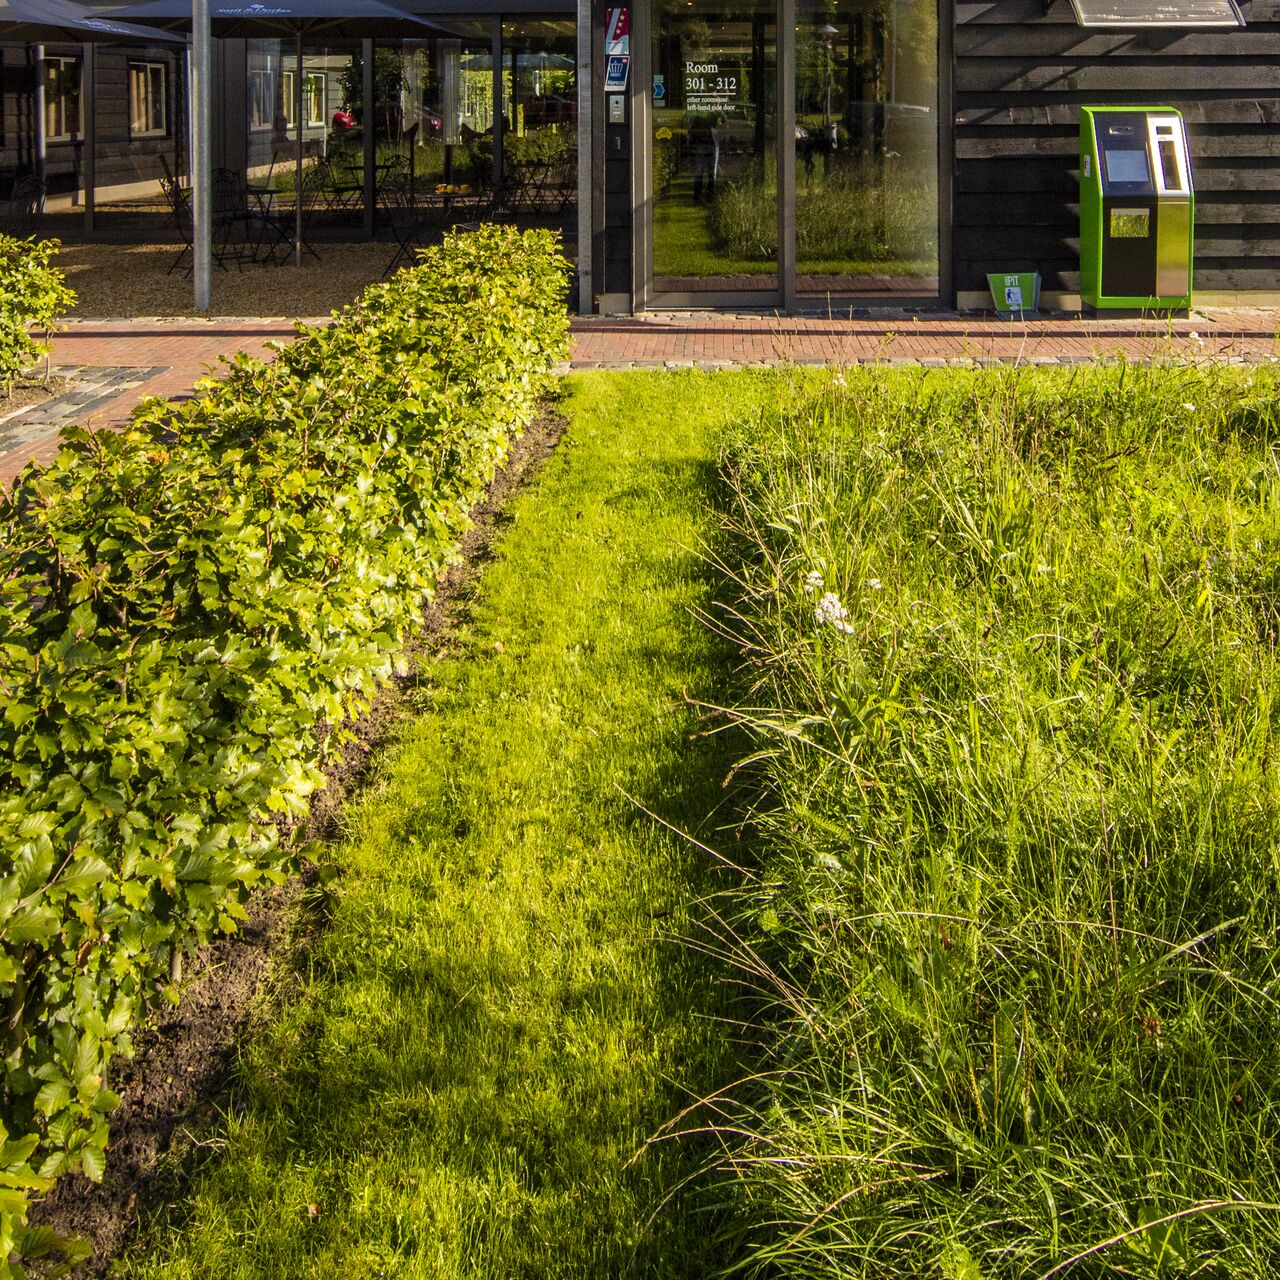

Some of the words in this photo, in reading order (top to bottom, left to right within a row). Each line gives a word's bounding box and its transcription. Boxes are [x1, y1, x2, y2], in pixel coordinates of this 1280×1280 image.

[685, 61, 718, 73] Room
[685, 77, 705, 89] 301
[716, 77, 737, 89] 312
